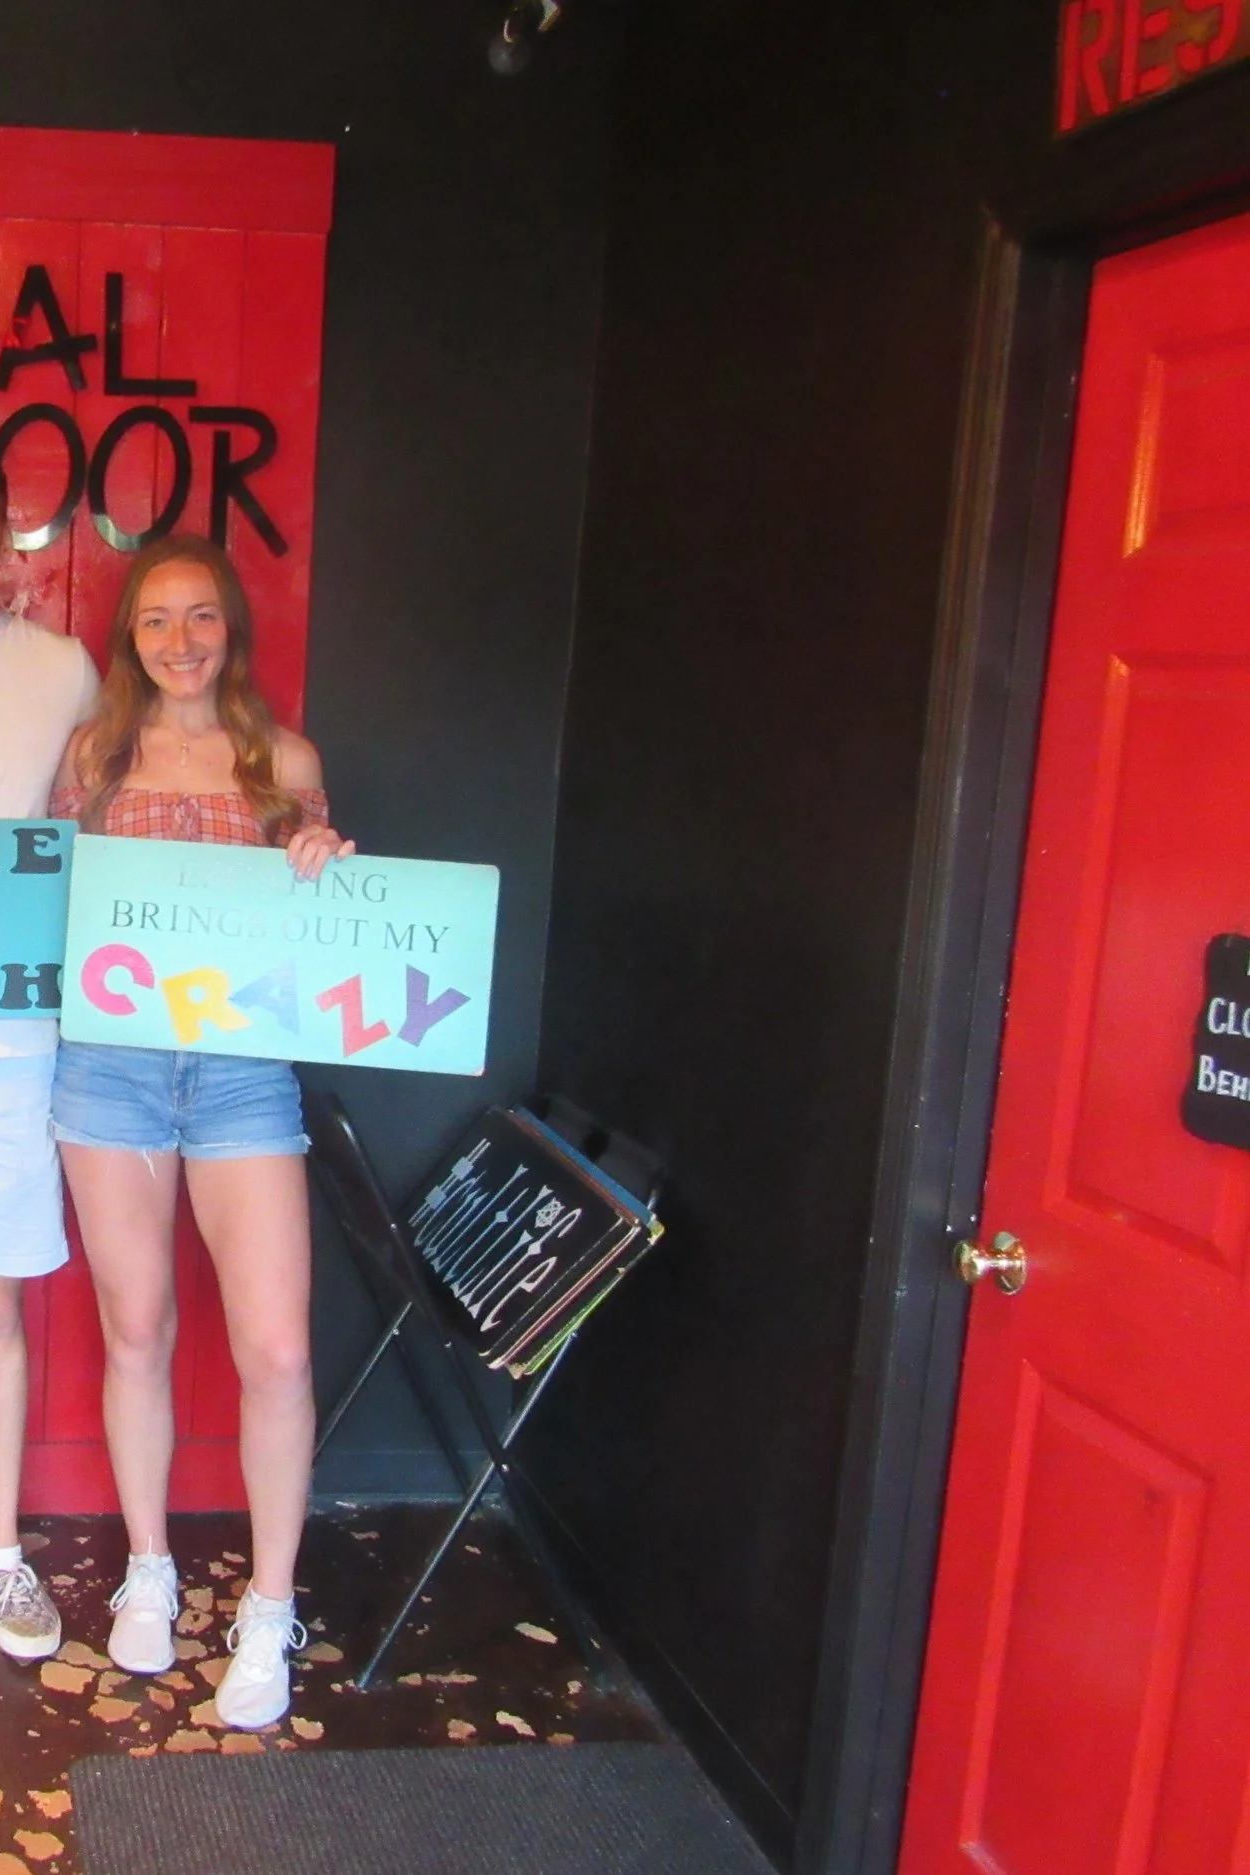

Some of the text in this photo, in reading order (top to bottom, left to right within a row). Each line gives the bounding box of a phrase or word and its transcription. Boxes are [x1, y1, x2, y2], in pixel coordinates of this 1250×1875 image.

[281, 913, 371, 949] OUT
[383, 921, 451, 954] MY
[81, 943, 472, 1057] CRAZY
